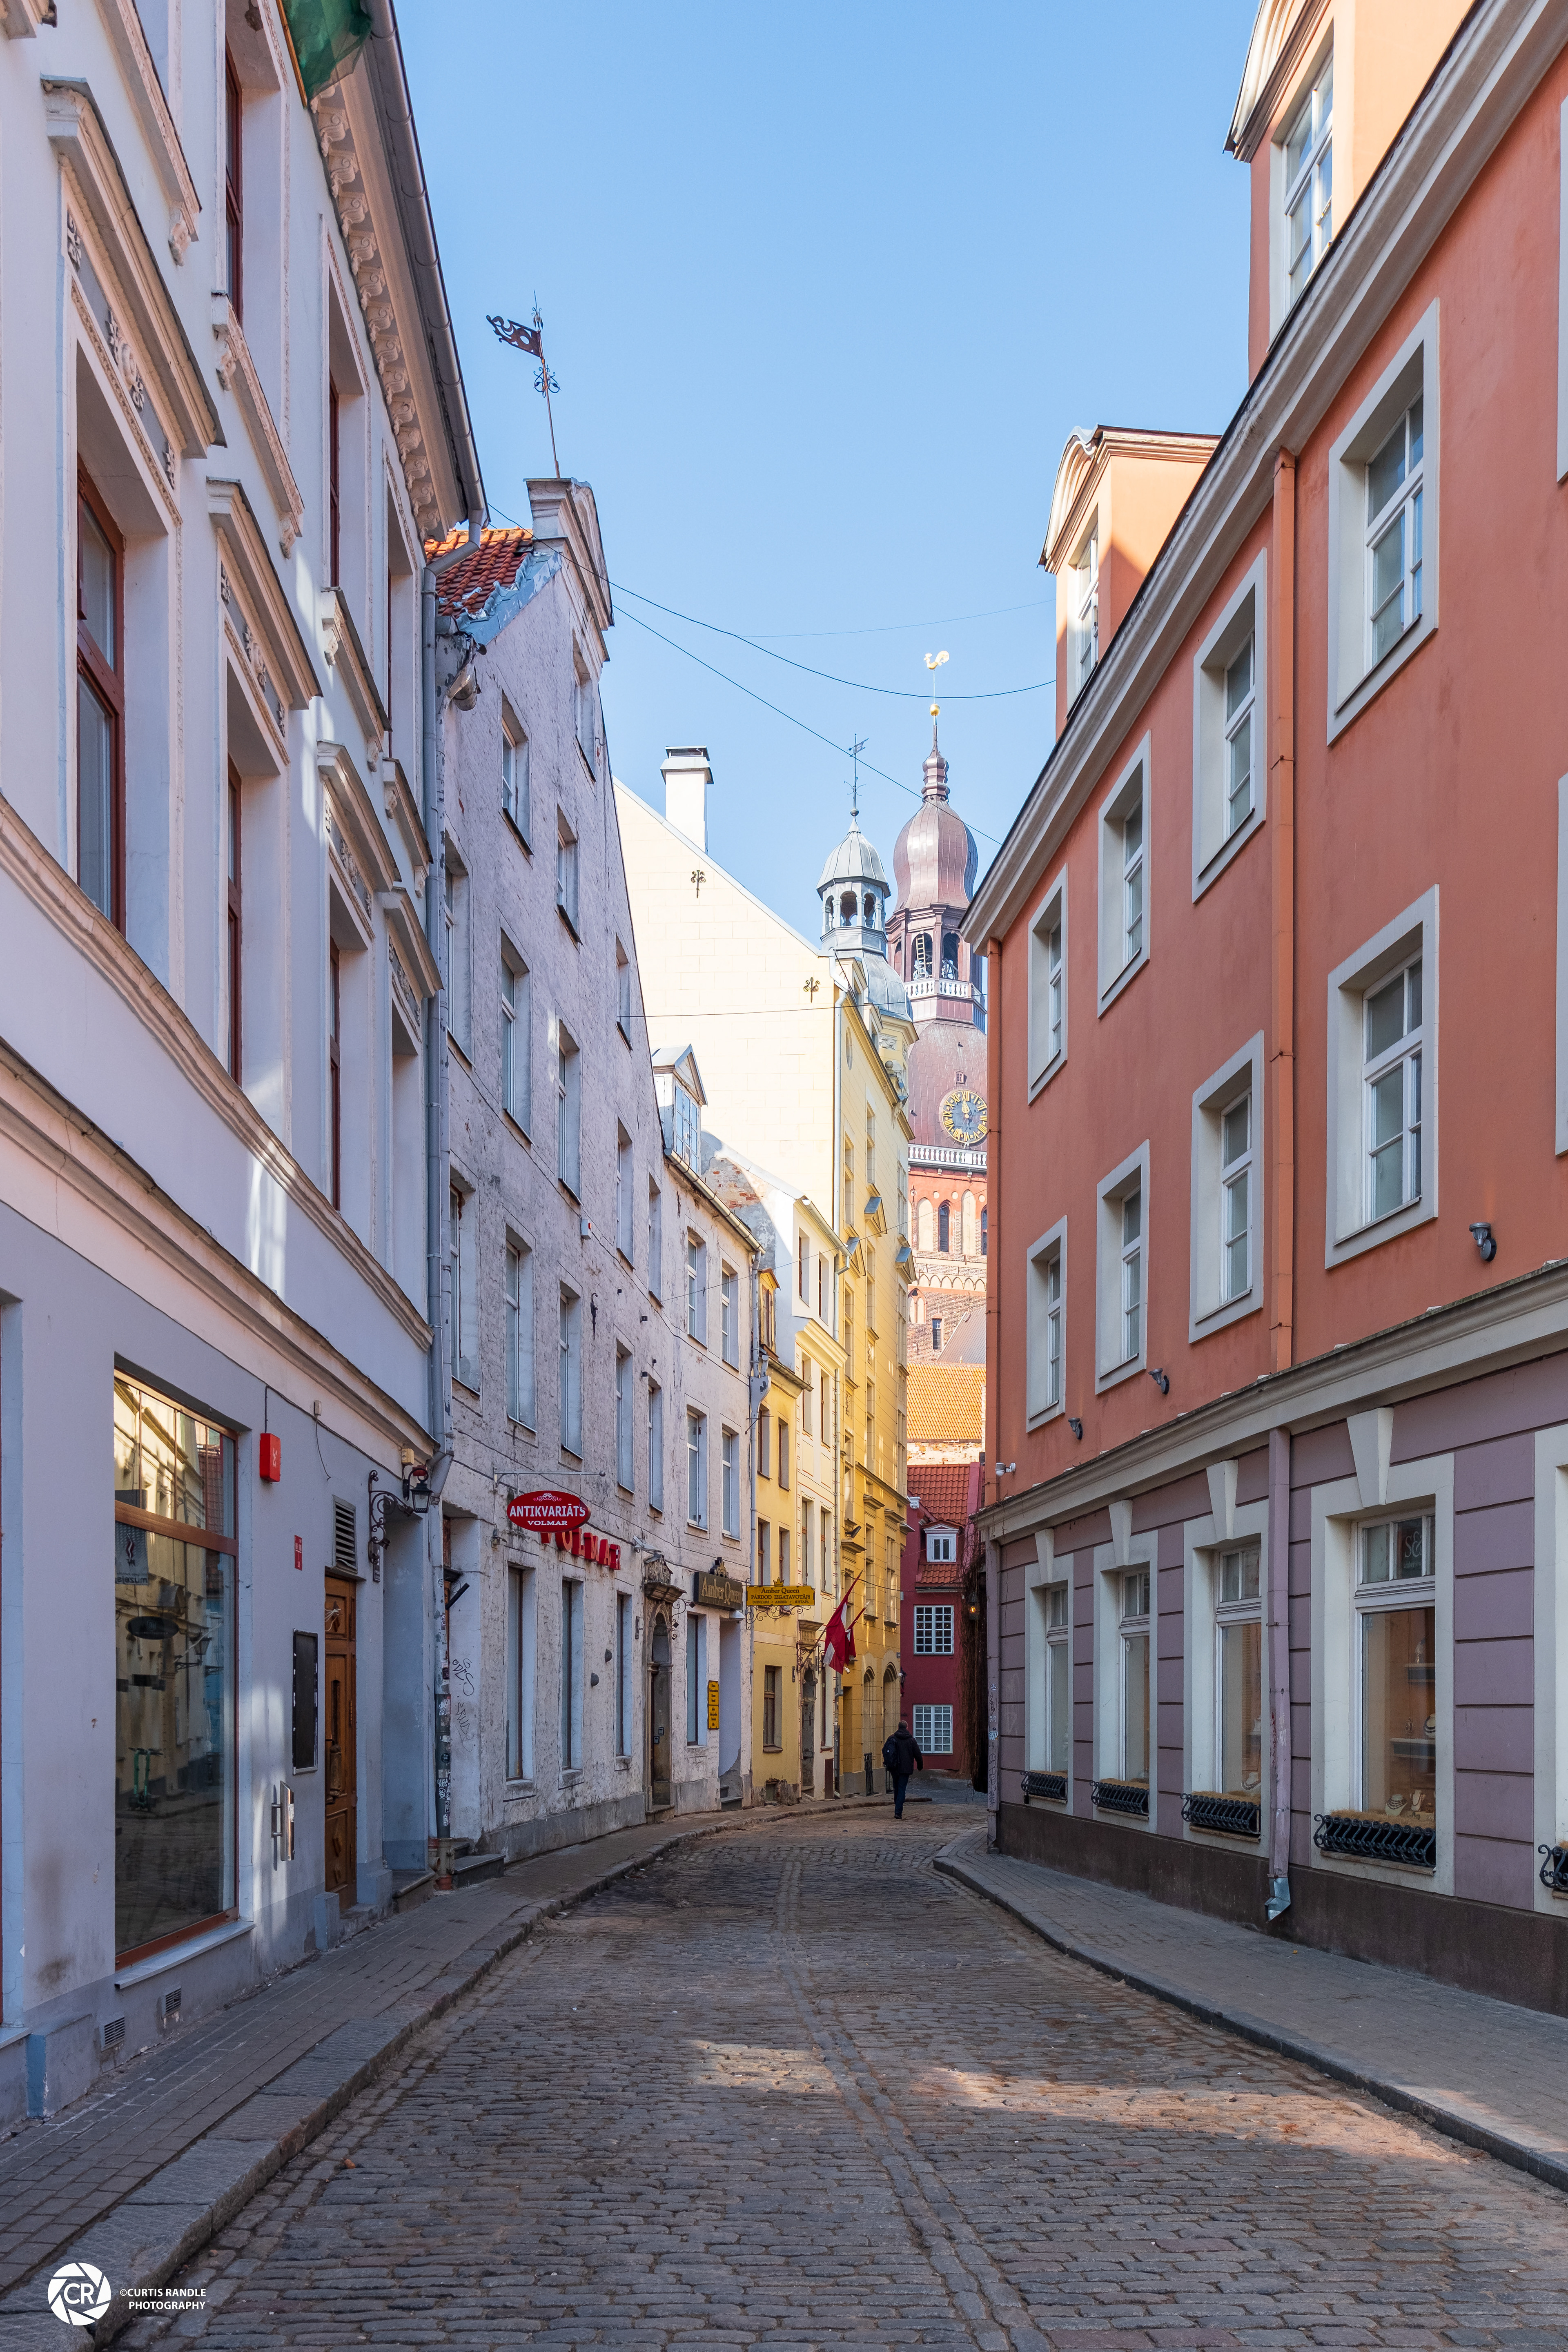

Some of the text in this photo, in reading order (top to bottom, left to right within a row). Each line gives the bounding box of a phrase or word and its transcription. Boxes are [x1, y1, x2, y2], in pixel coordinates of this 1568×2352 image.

[510, 1503, 585, 1517] ANTIKVARIĀTS
[701, 1576, 742, 1605] Amber Queen
